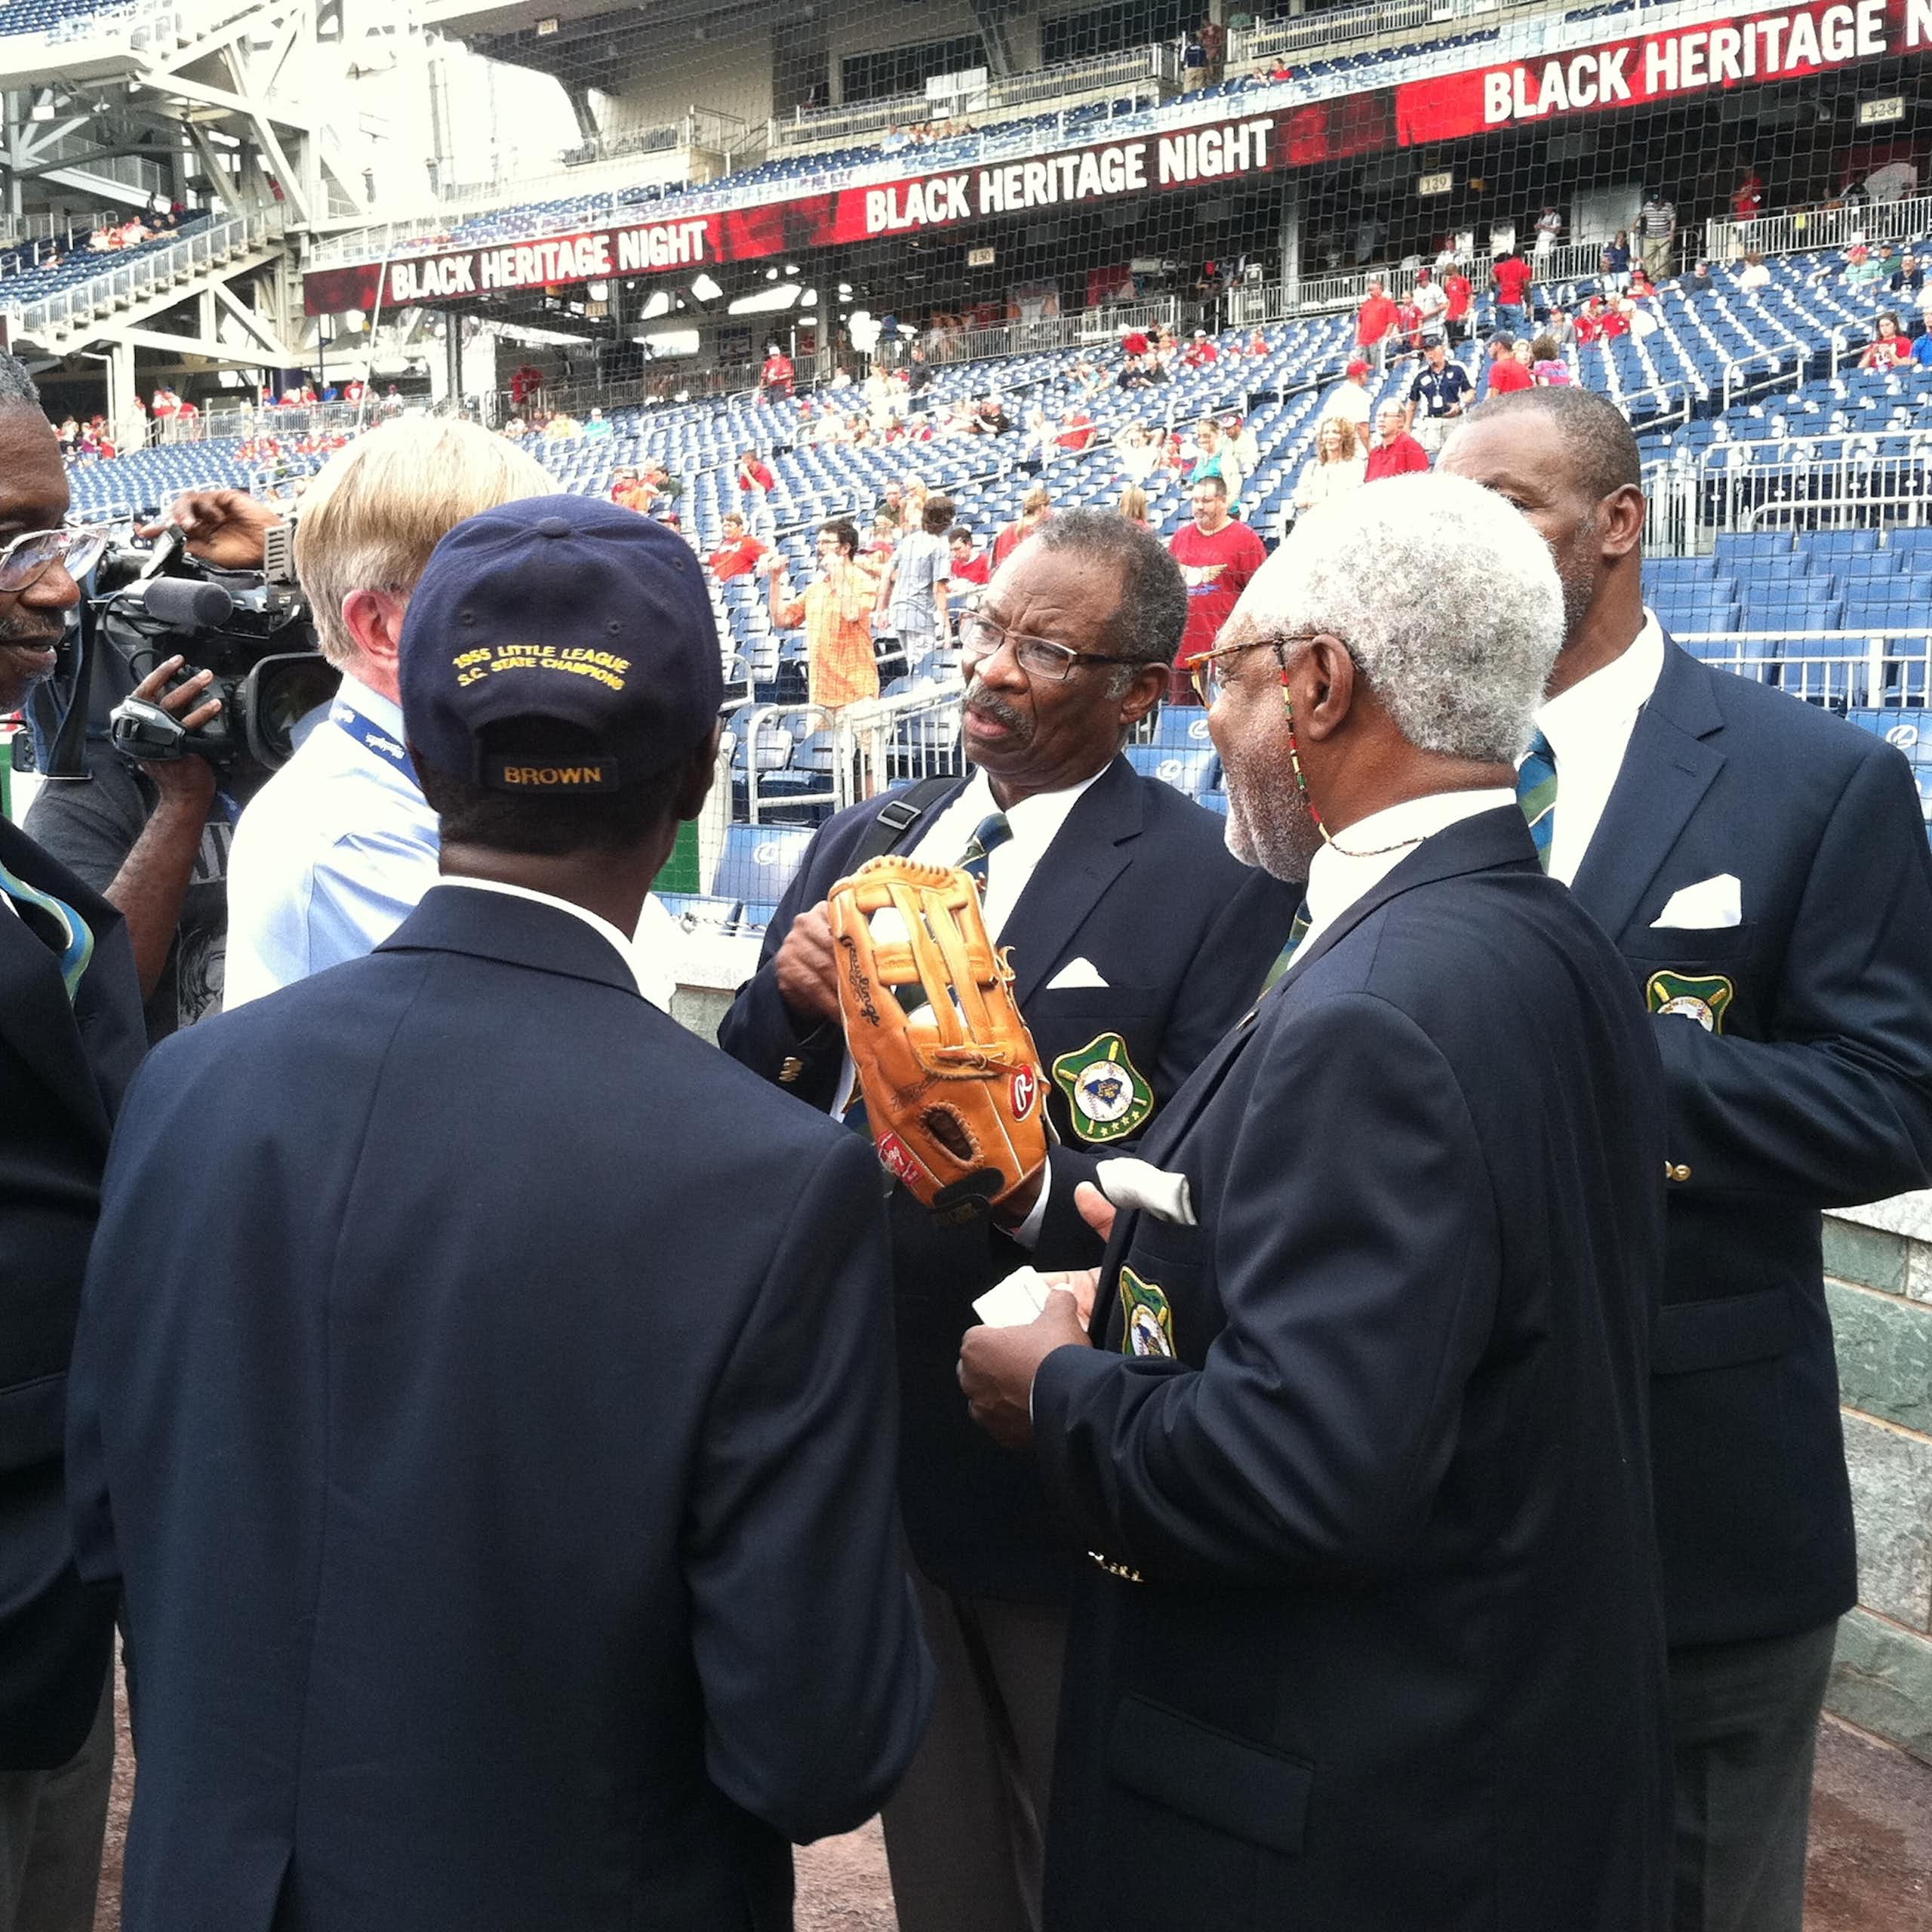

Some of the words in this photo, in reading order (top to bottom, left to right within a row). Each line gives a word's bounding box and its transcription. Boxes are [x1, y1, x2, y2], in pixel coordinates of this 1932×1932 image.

[1484, 47, 1631, 124] BLACK
[1645, 0, 1887, 95] HERITAGE
[866, 174, 971, 232] BLACK
[980, 144, 1147, 214] HERITAGE
[1158, 119, 1274, 184] NIGHT
[390, 254, 475, 301] BLACK
[481, 235, 611, 289] HERITAGE
[618, 220, 708, 270] NIGHT
[453, 648, 492, 669] 1955
[497, 645, 557, 657] LITTLE
[561, 648, 632, 674] LEAGUE
[491, 657, 537, 672] STATE
[539, 658, 626, 691] CHAMPIONS
[503, 766, 602, 786] BROWN
